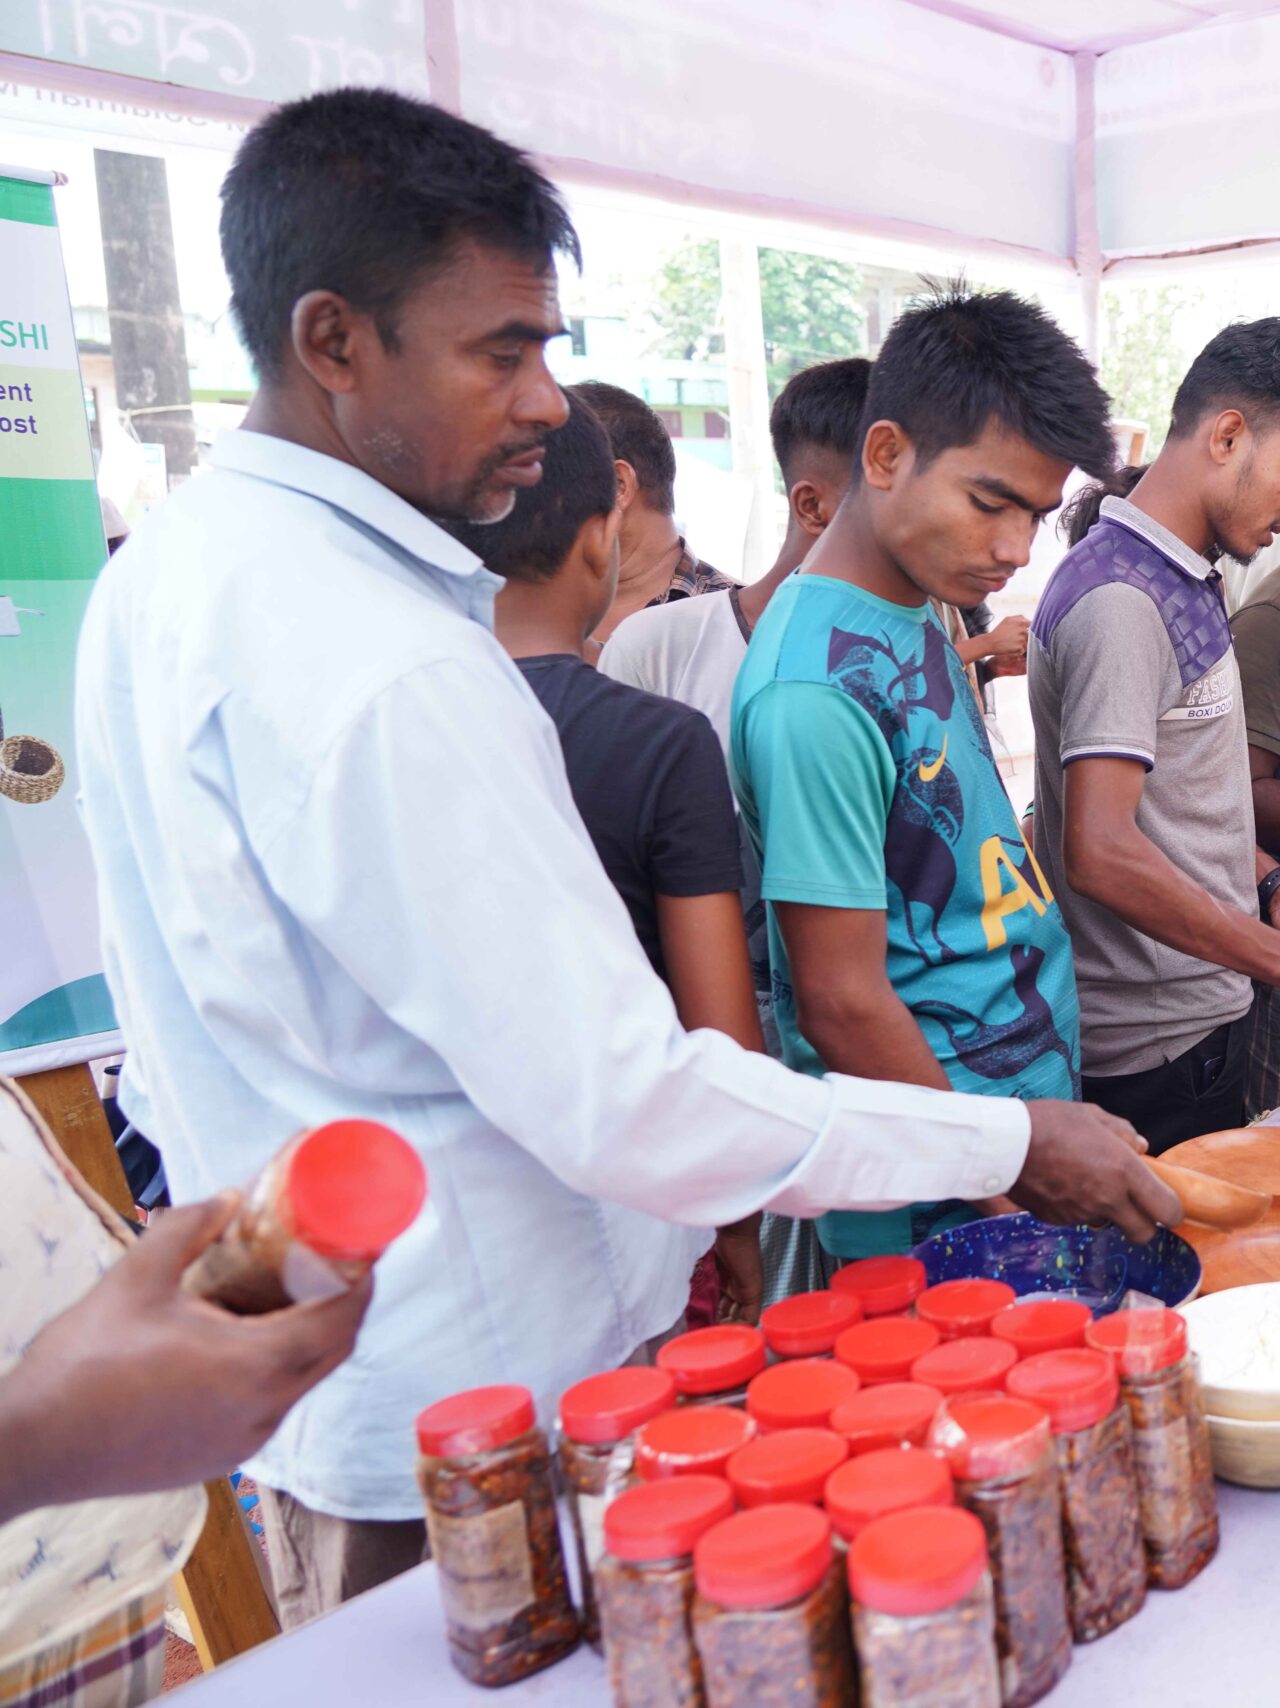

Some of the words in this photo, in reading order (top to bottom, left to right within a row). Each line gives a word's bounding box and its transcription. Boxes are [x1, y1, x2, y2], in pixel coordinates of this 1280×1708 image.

[0, 319, 49, 350] SHI
[0, 415, 38, 435] ost
[1187, 707, 1214, 718] BOXI
